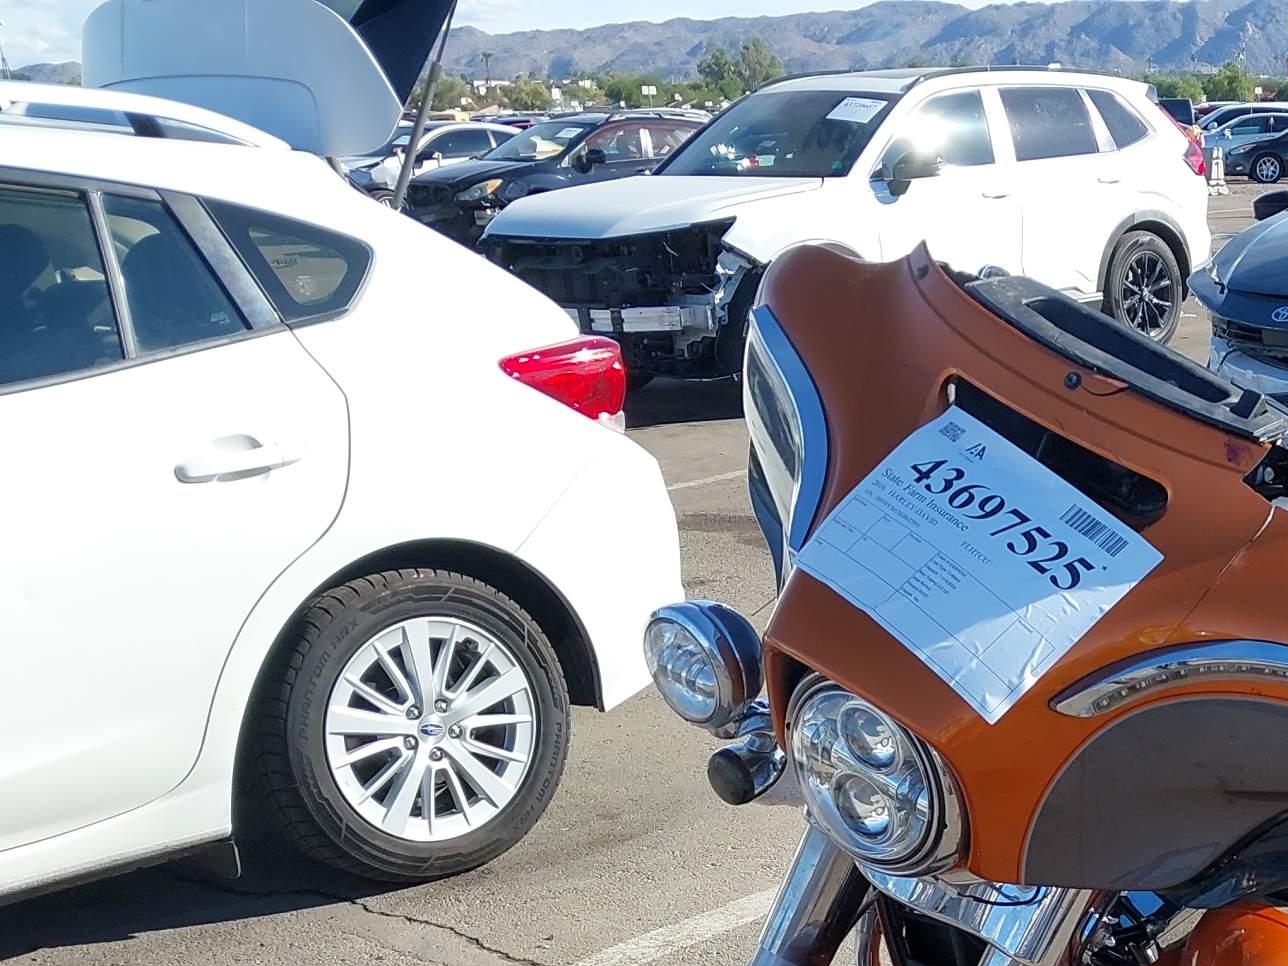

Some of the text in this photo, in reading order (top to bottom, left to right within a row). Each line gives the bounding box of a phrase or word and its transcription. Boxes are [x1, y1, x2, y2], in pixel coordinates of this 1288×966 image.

[881, 467, 904, 487] State
[903, 483, 927, 504] Farm
[926, 499, 969, 532] Insurance
[910, 459, 1096, 590] 43697525
